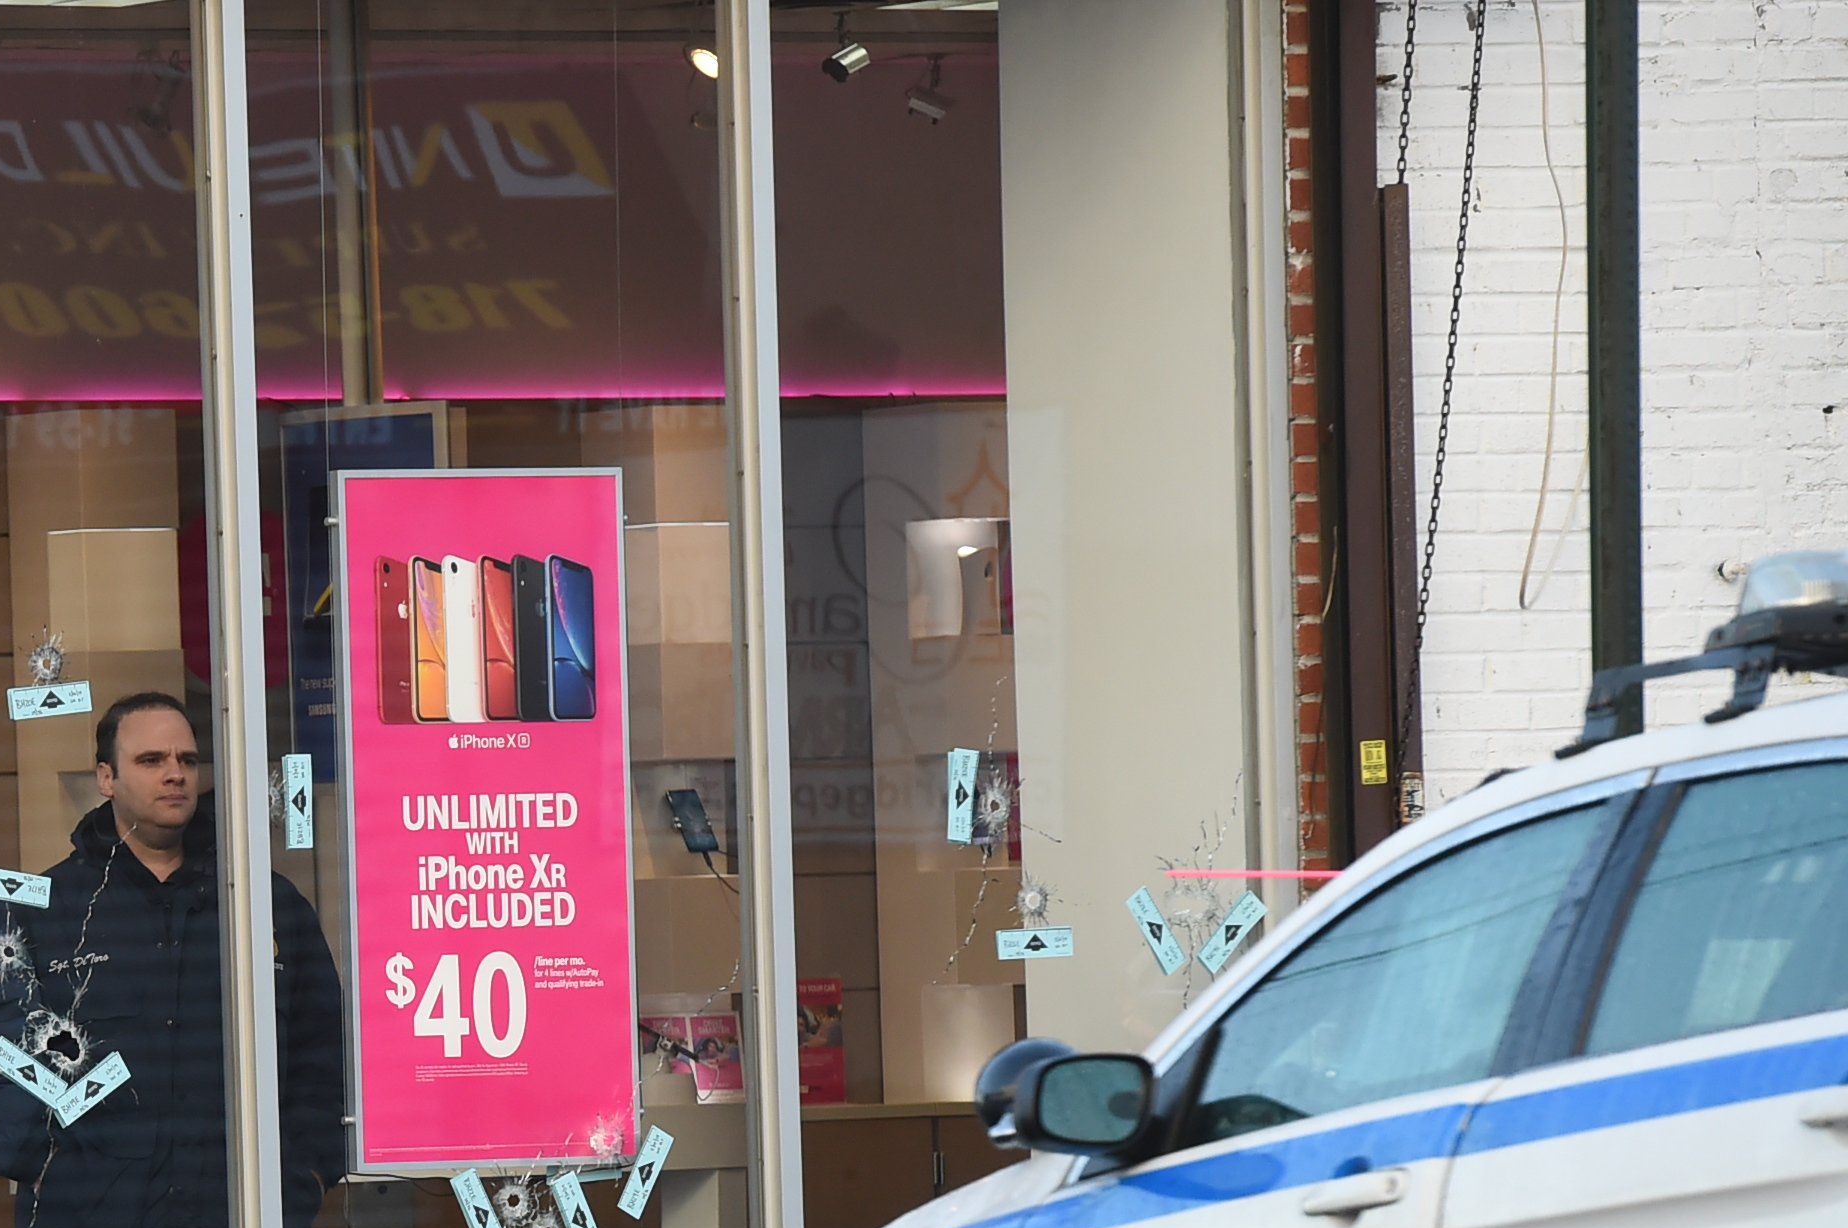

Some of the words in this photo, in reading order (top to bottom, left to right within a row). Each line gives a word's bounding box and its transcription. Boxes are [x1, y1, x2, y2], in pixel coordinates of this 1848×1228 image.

[460, 734, 505, 749] iPhone
[401, 792, 579, 831] UNLIMITED
[465, 831, 520, 855] WITH
[418, 855, 525, 891] iPhone
[529, 853, 567, 888] XR
[410, 891, 576, 930] INCLUDED
[534, 968, 543, 978] for
[550, 968, 565, 978] lines
[554, 957, 569, 969] per
[570, 956, 586, 967] mo.
[534, 980, 547, 989] and
[548, 979, 579, 990] qualifying
[385, 950, 528, 1059] $40
